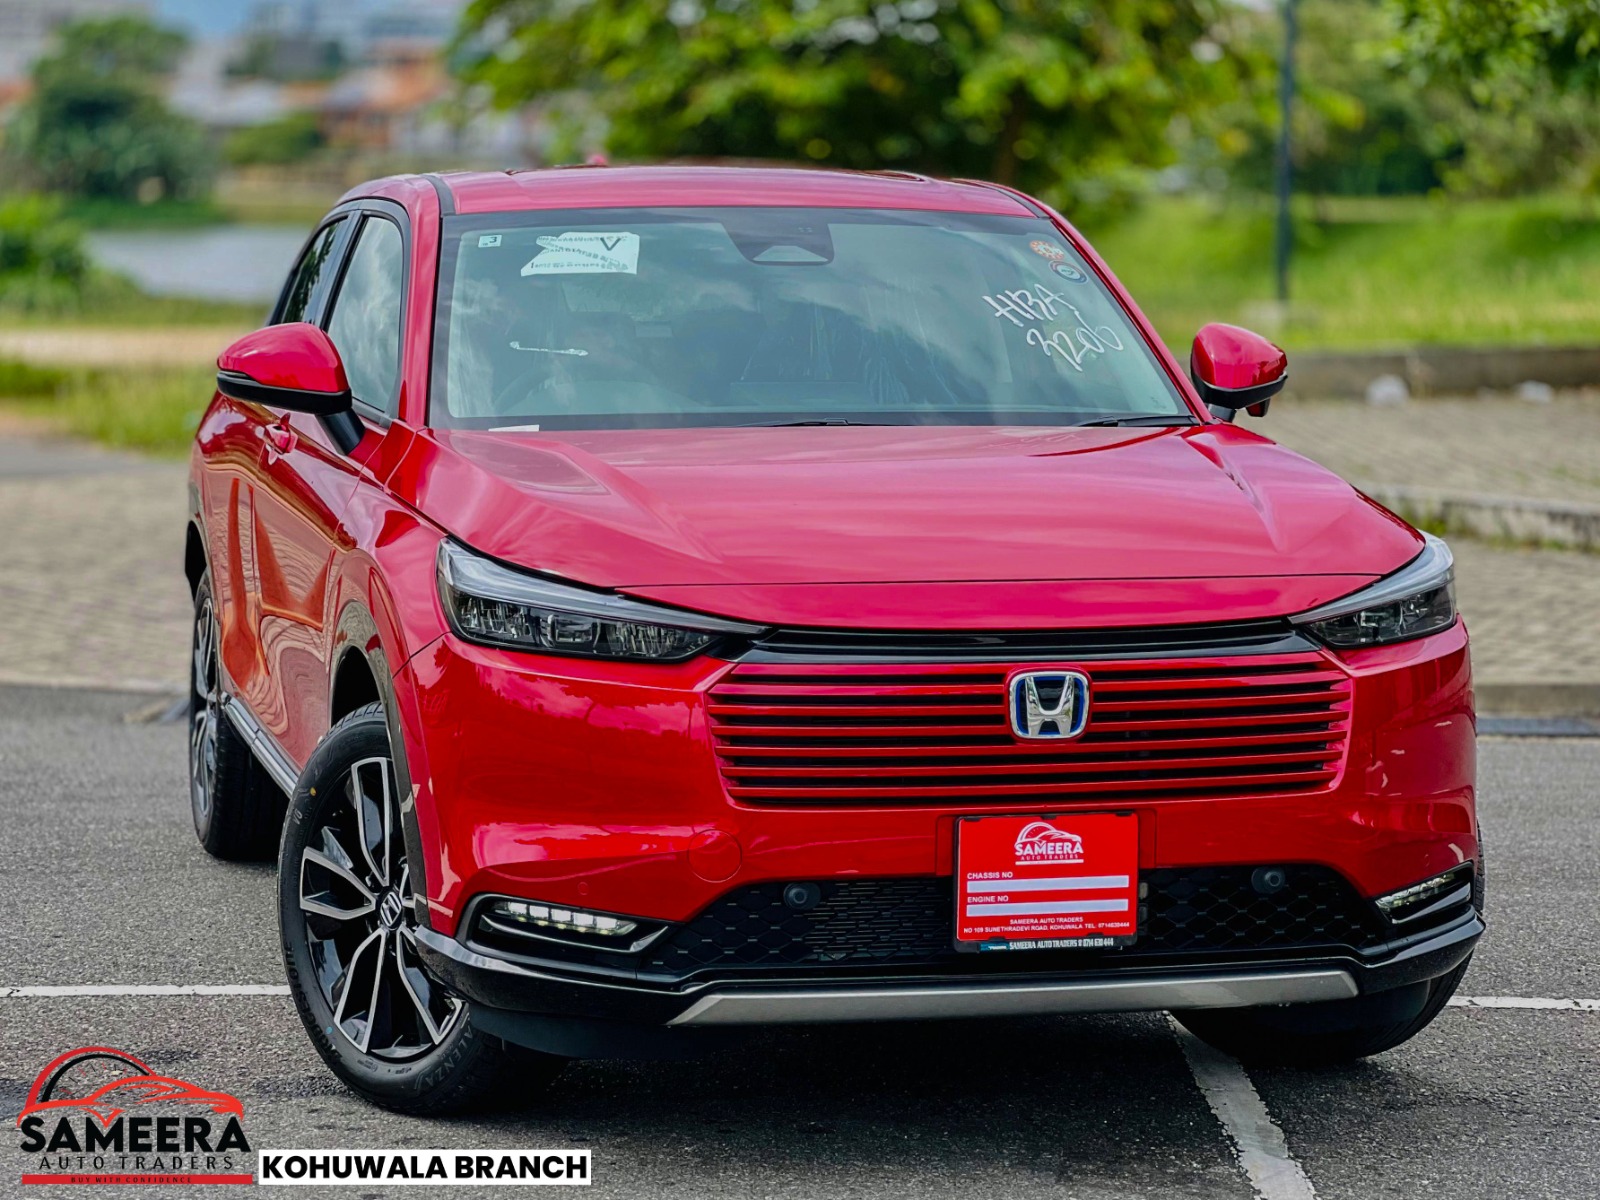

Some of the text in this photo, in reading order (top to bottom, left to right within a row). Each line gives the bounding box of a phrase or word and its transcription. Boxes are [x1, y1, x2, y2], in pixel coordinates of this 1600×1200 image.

[1015, 841, 1084, 855] SAMEERA
[967, 871, 1013, 880] CHASSIS NO
[967, 895, 996, 903] ENGINE
[1009, 941, 1036, 950] SAMEERA
[1036, 940, 1053, 949] AUTO
[1052, 939, 1078, 948] TRADERS
